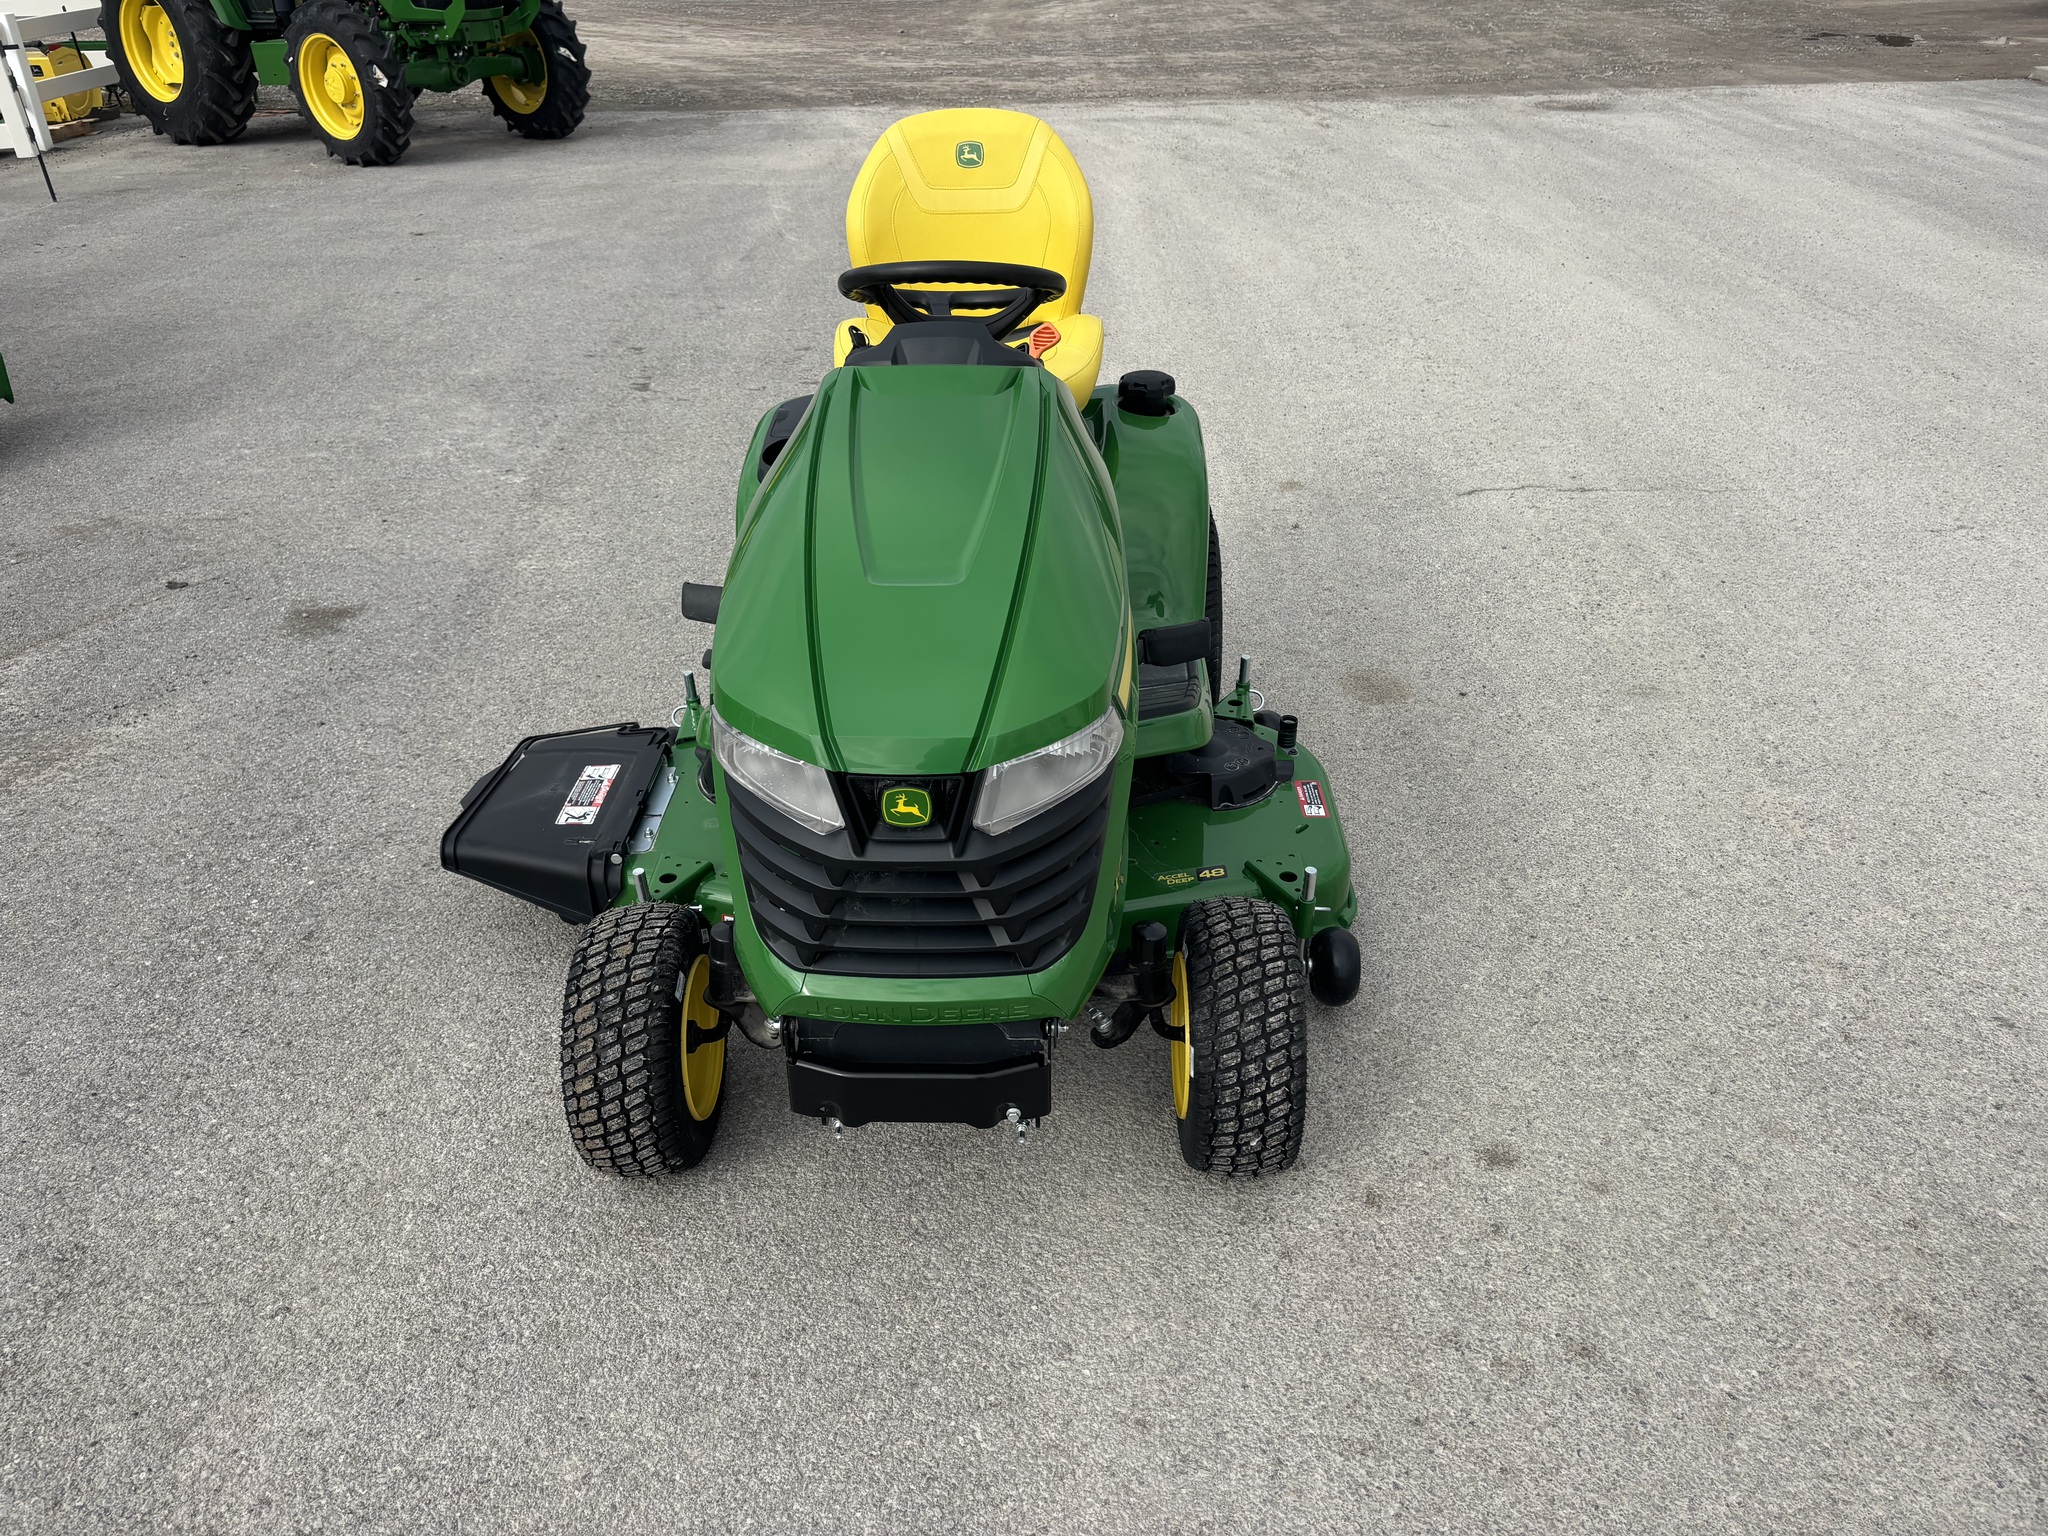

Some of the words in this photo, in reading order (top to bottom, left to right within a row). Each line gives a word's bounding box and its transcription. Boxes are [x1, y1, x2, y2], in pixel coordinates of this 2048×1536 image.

[1157, 872, 1190, 881] ACCEL
[1199, 868, 1225, 878] 48
[1166, 876, 1195, 885] DEEP
[808, 1001, 901, 1022] JOHN
[911, 1004, 1030, 1023] DEERE
